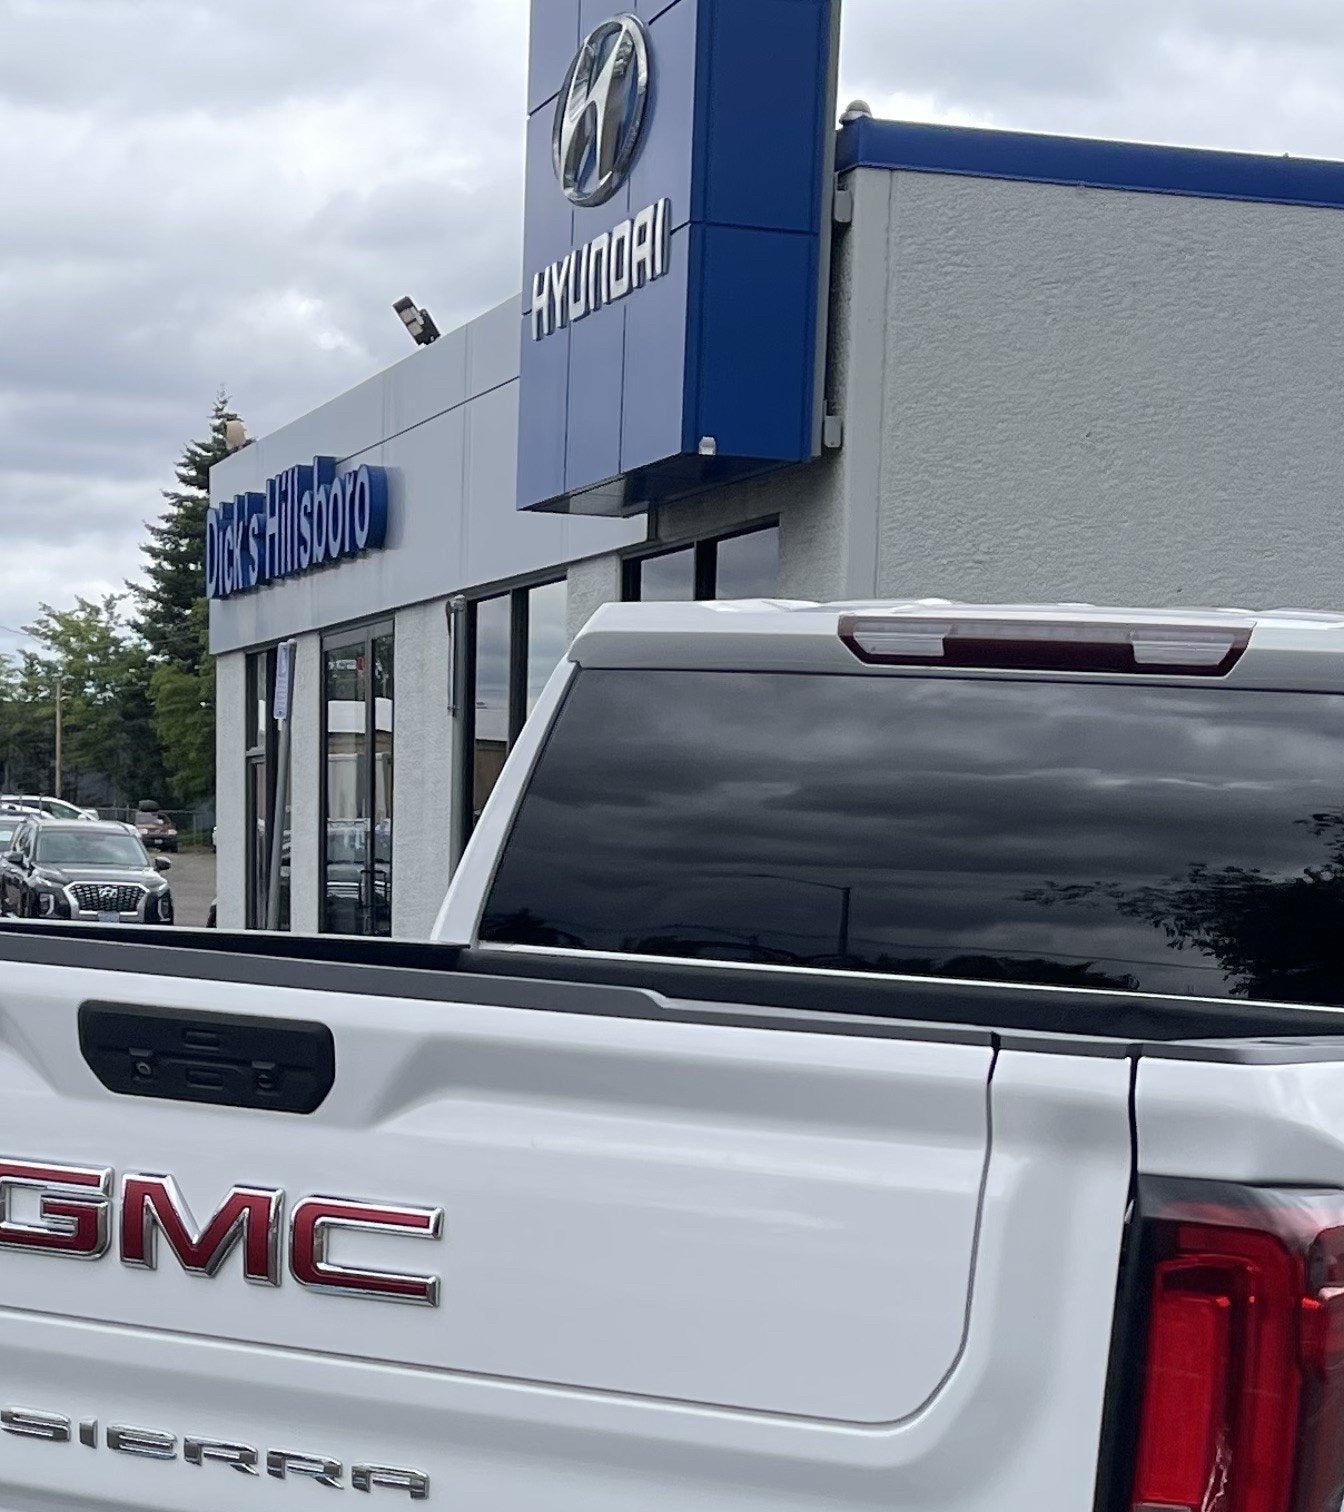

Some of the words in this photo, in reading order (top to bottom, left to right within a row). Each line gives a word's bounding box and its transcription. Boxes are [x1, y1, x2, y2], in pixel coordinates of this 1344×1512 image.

[532, 197, 671, 341] HYUNDAI
[207, 492, 261, 598] Dick's
[265, 456, 378, 580] Hillsboro
[0, 1407, 429, 1500] SIERRA
